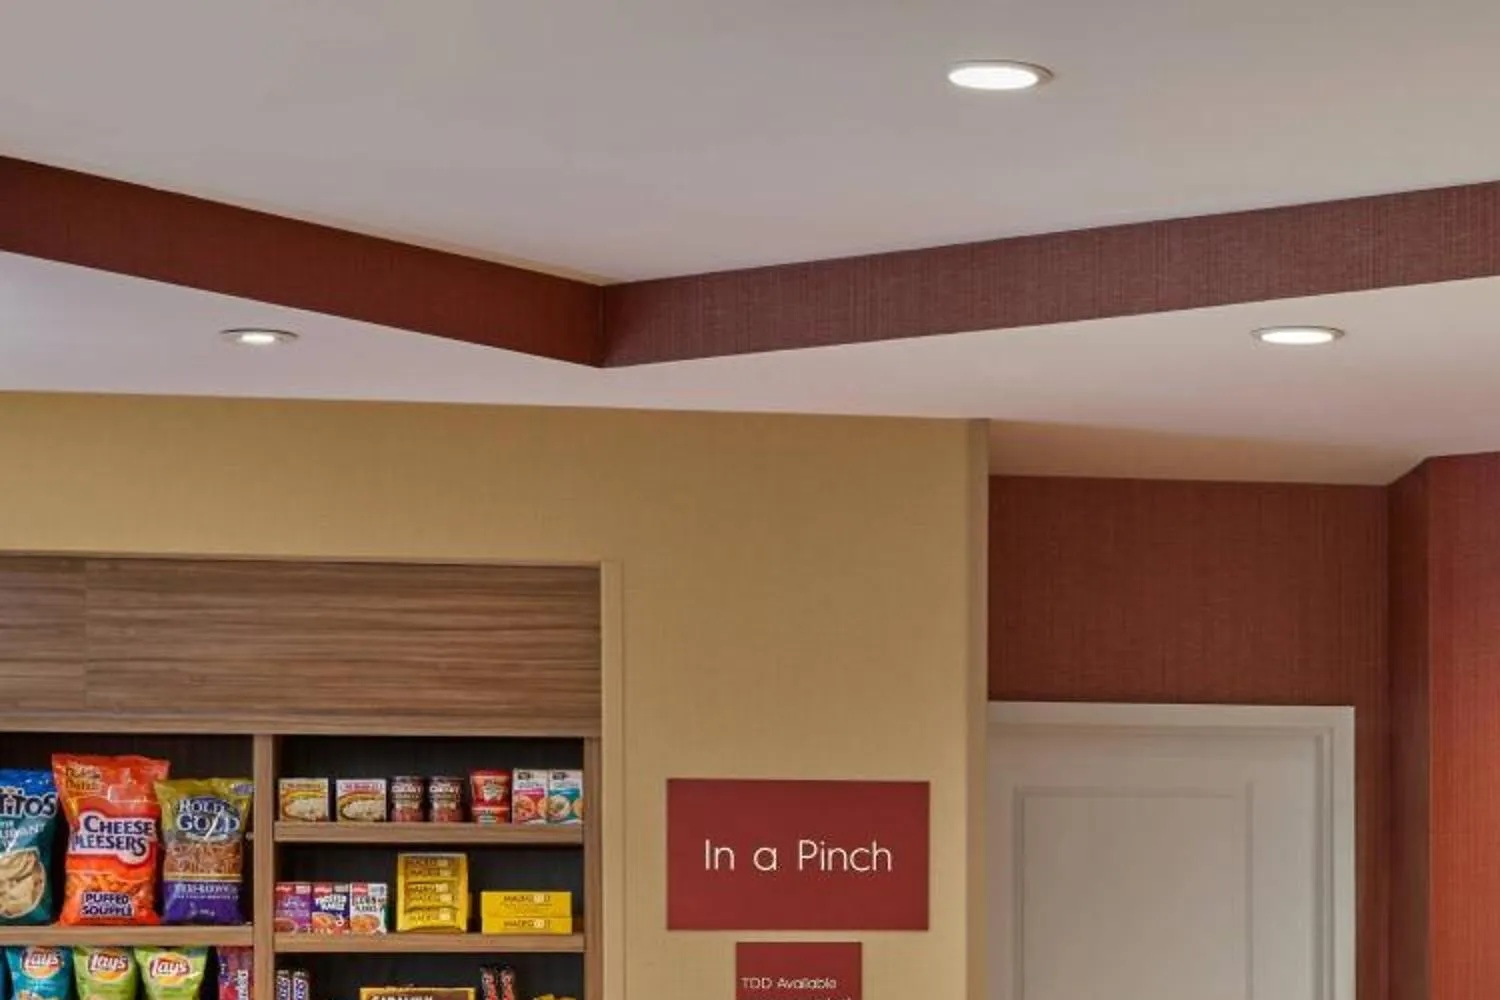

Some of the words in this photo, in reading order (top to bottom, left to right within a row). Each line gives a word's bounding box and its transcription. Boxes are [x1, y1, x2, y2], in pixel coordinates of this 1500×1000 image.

[84, 816, 153, 836] CHEESE
[705, 839, 735, 871] In
[753, 846, 778, 871] a
[798, 839, 892, 872] Pinch
[741, 977, 773, 989] TDD
[777, 977, 837, 989] Available
